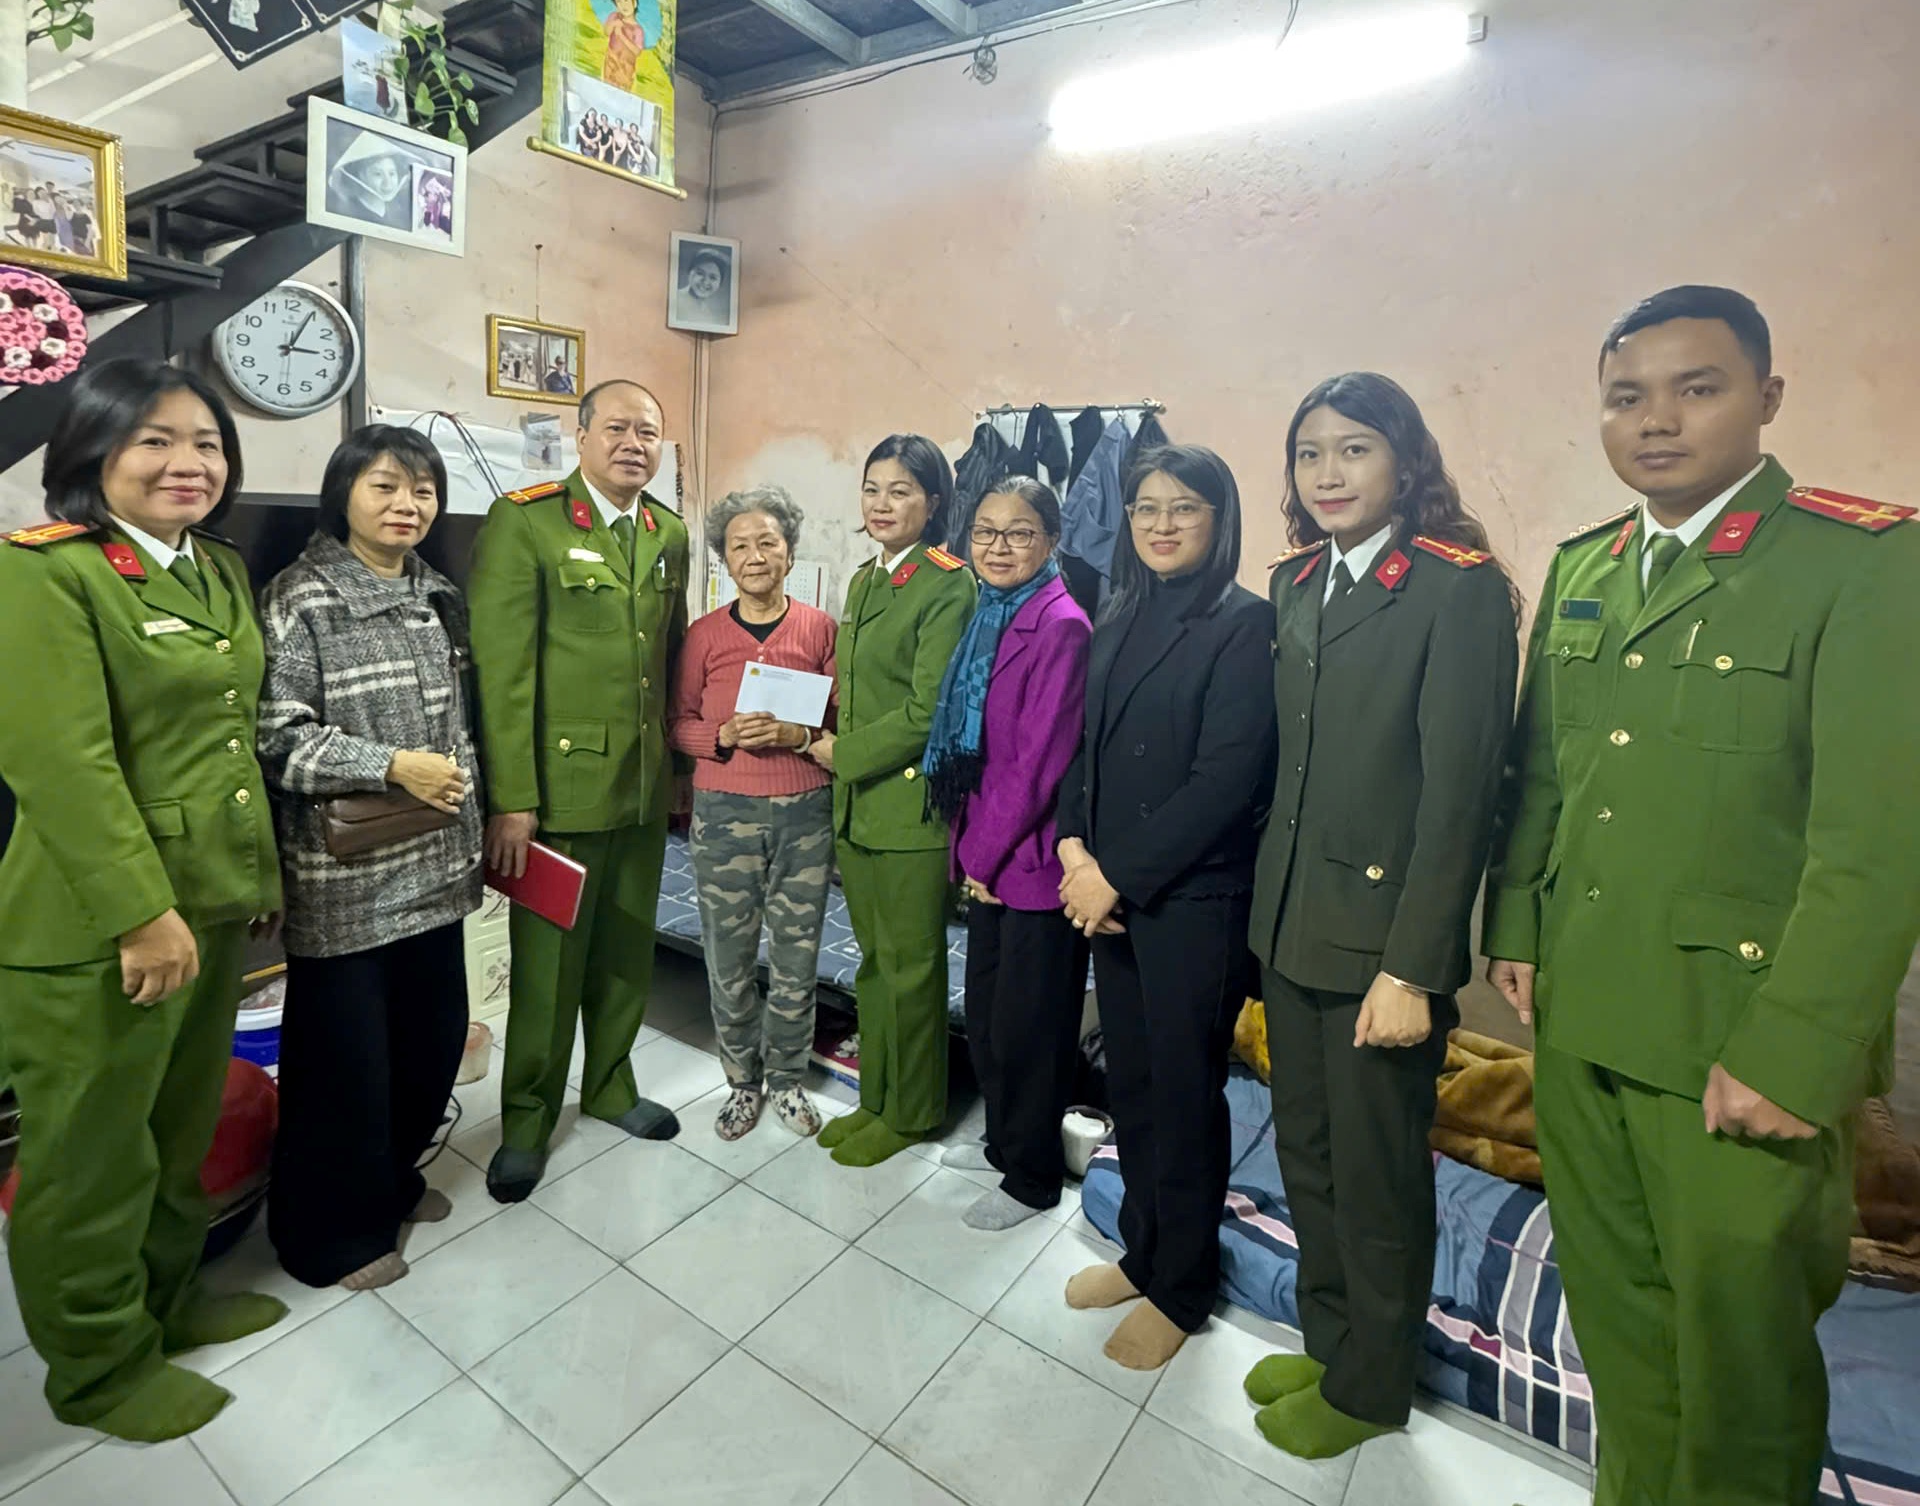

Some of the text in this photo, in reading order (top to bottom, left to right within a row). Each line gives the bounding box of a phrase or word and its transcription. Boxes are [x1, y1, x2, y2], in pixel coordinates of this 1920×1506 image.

[264, 301, 276, 314] 11
[284, 299, 301, 312] 12
[245, 315, 262, 328] 10
[236, 333, 250, 346] 9
[319, 328, 333, 341] 2
[322, 349, 336, 361] 3
[241, 356, 255, 368] 8
[315, 368, 328, 379] 4
[256, 374, 269, 386] 7
[277, 383, 291, 395] 6
[299, 381, 312, 392] 5
